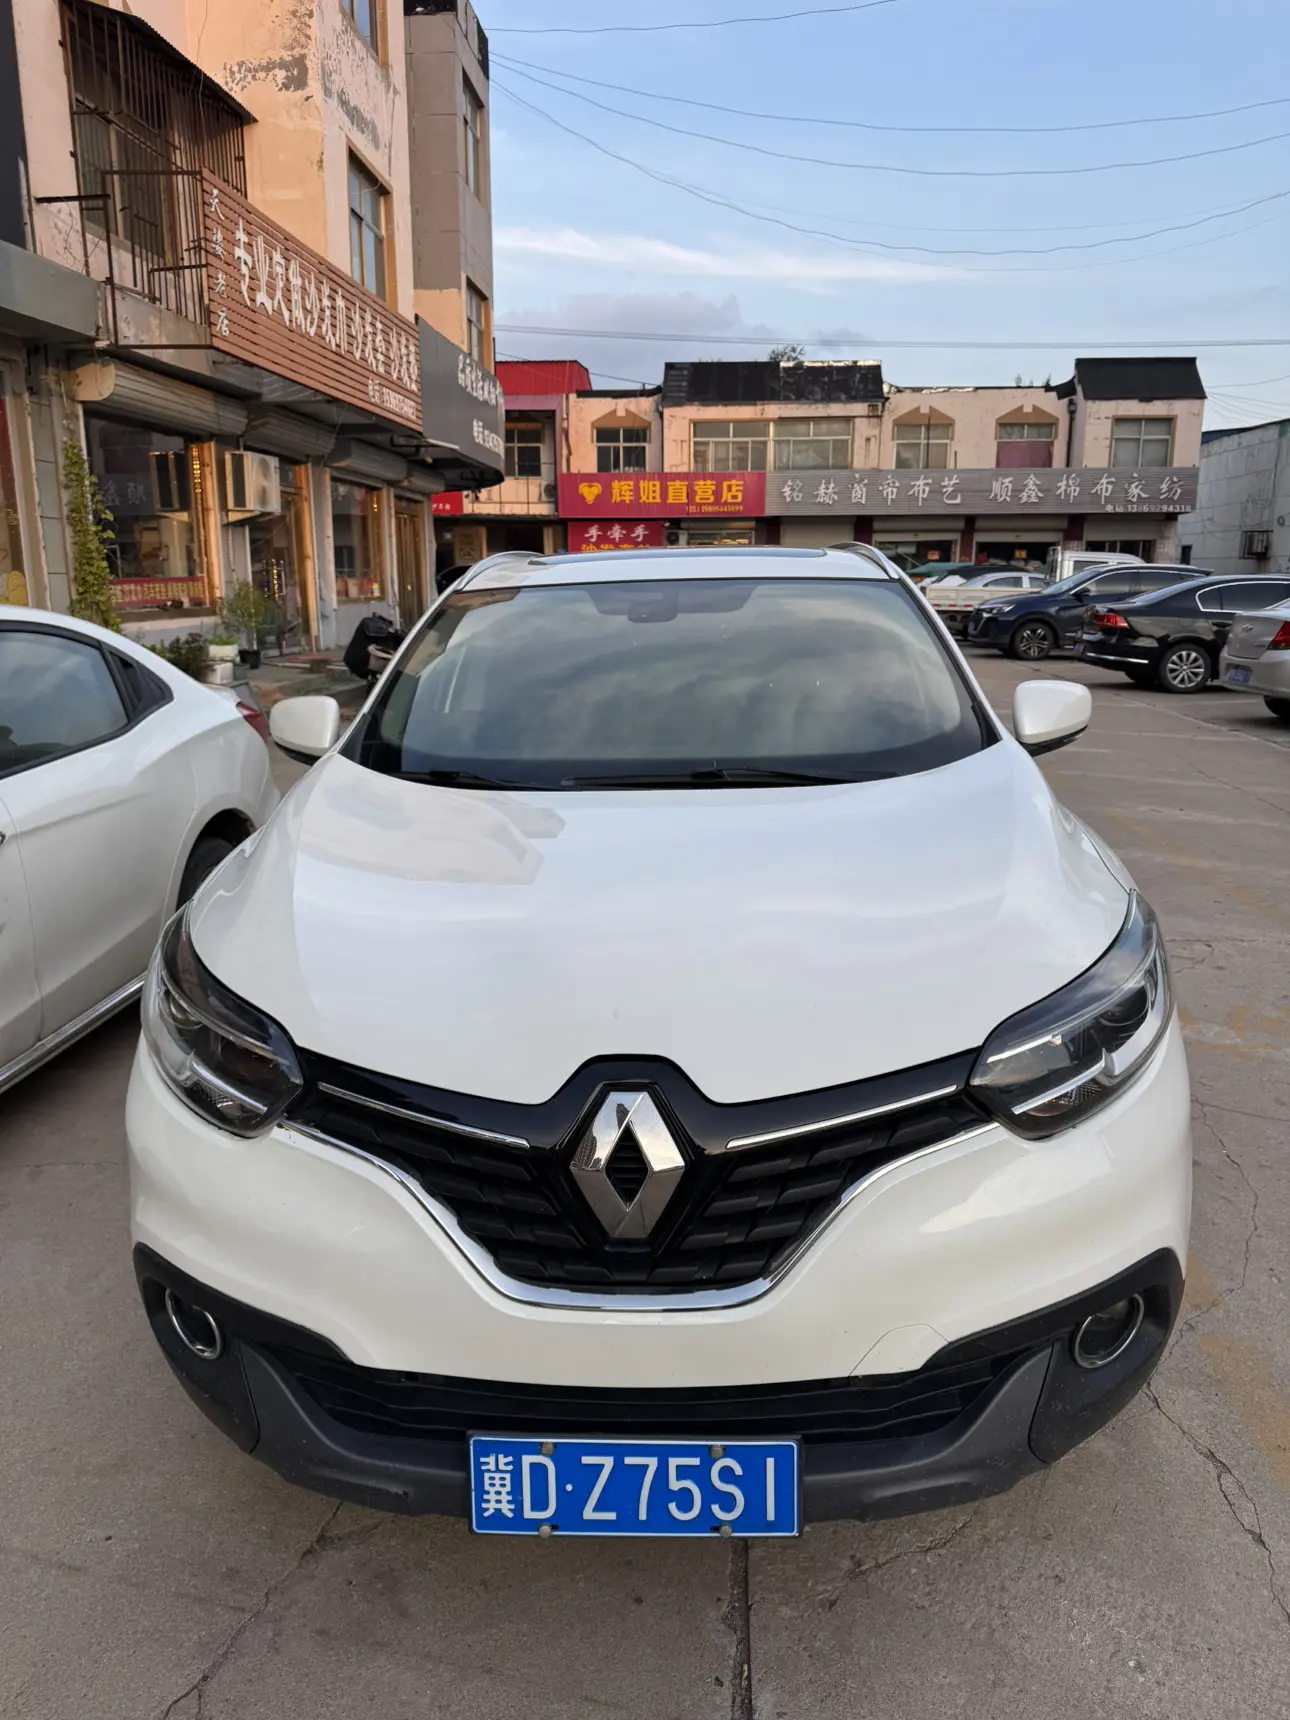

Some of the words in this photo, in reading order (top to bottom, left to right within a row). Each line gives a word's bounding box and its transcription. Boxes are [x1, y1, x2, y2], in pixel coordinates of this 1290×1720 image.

[610, 479, 745, 505] 辉姐直营店
[988, 472, 1185, 505] 顺鑫棉布家纺
[583, 523, 650, 543] 手牵手
